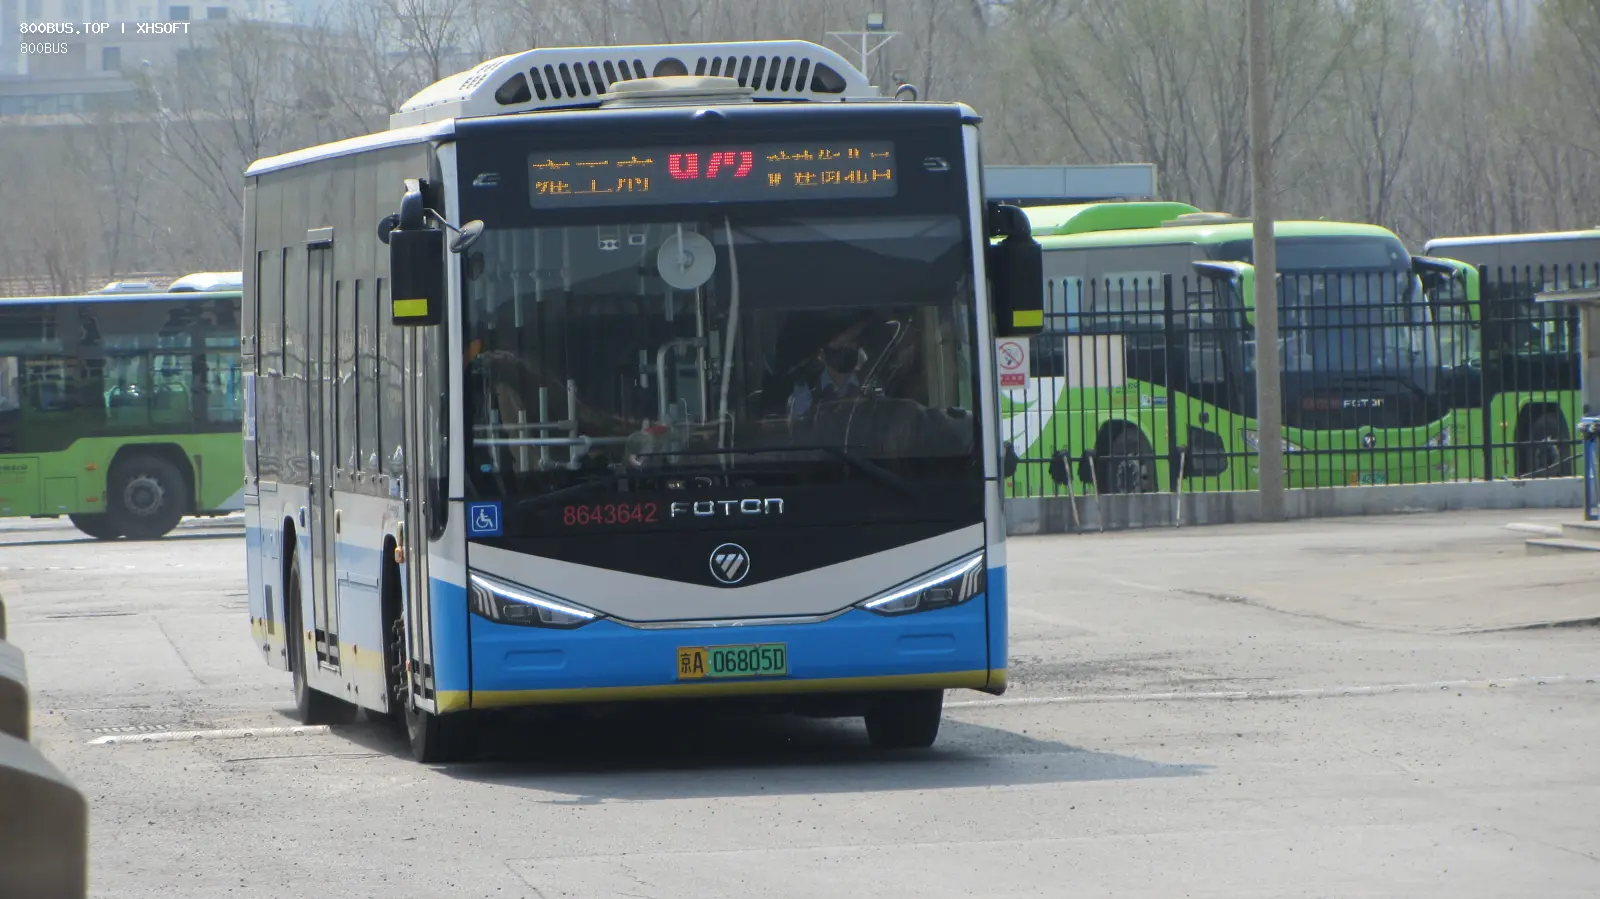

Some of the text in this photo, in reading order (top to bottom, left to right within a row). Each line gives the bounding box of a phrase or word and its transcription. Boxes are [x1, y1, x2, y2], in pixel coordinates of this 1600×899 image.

[563, 502, 658, 525] 8643642
[670, 497, 784, 518] FOTON
[713, 648, 785, 673] 06805D
